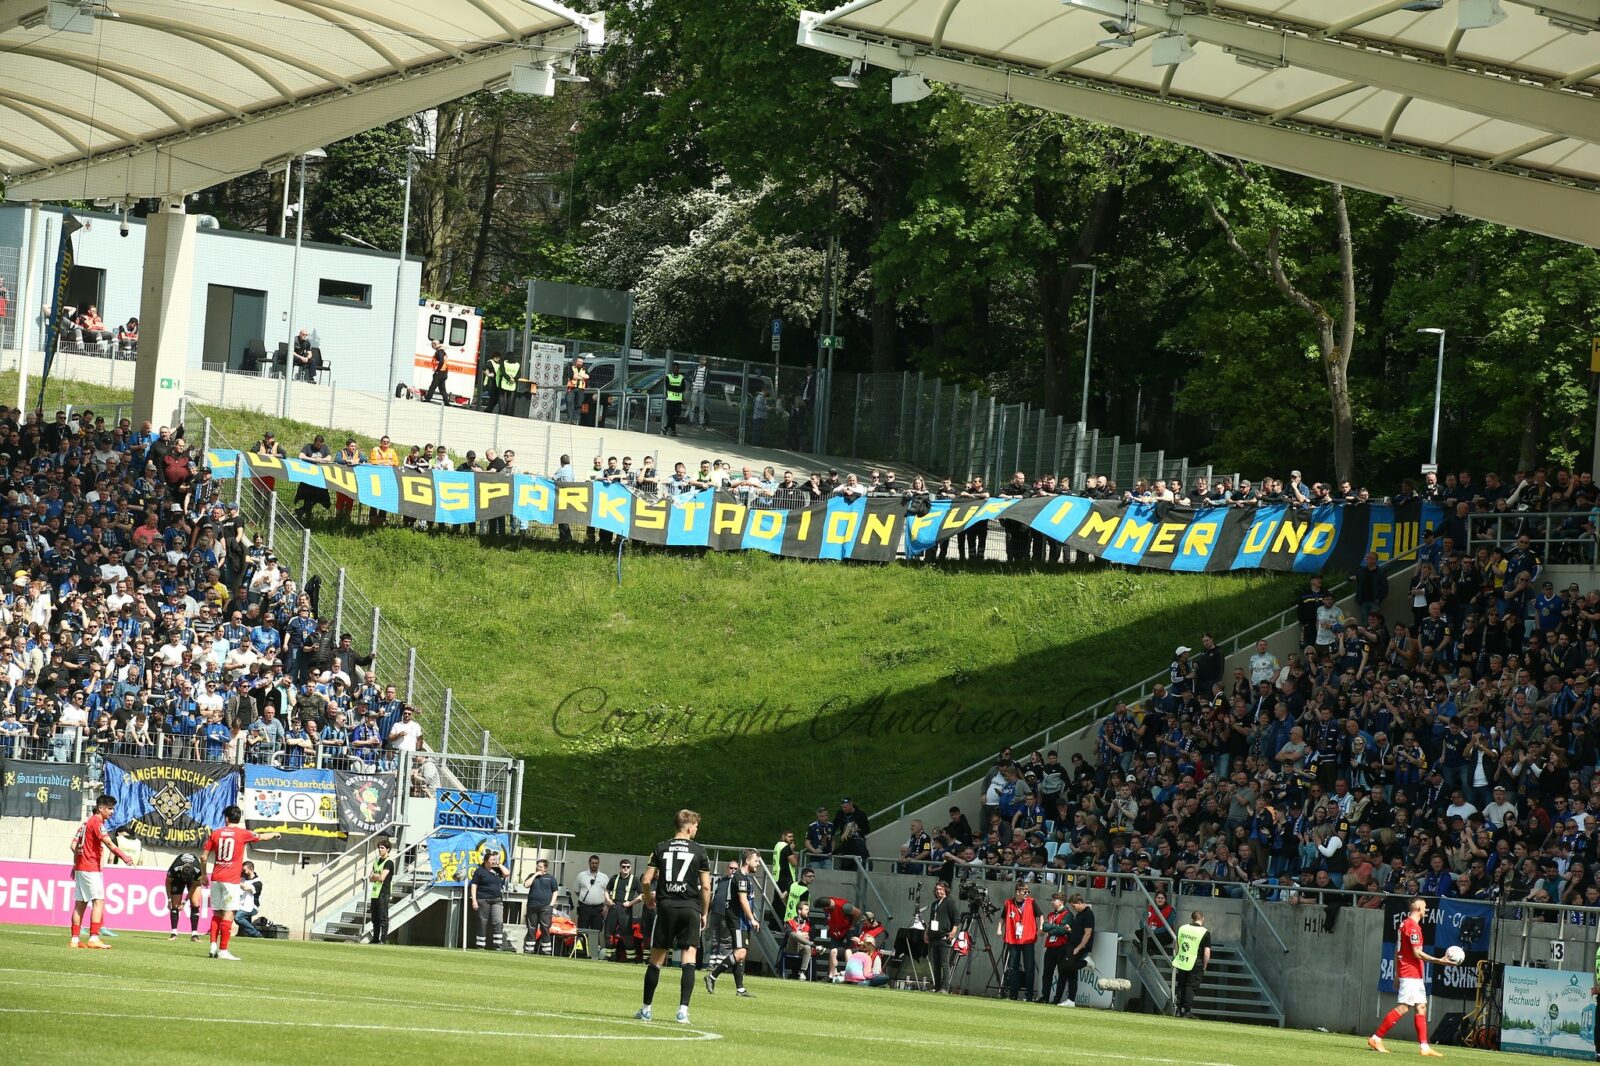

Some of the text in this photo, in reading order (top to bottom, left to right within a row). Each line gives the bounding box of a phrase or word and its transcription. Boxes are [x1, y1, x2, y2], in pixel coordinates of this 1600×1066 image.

[1051, 501, 1218, 556] IMMER
[1243, 519, 1335, 556] UND
[1370, 520, 1434, 561] EW
[123, 766, 220, 793] FANGEMEINSCHAFT
[130, 817, 162, 838] TREUE
[164, 827, 197, 842] JUNGS
[217, 837, 236, 862] 10
[302, 857, 311, 870] F
[662, 851, 695, 882] 17
[104, 882, 212, 919] SPOT
[1508, 993, 1541, 1007] Hochwald
